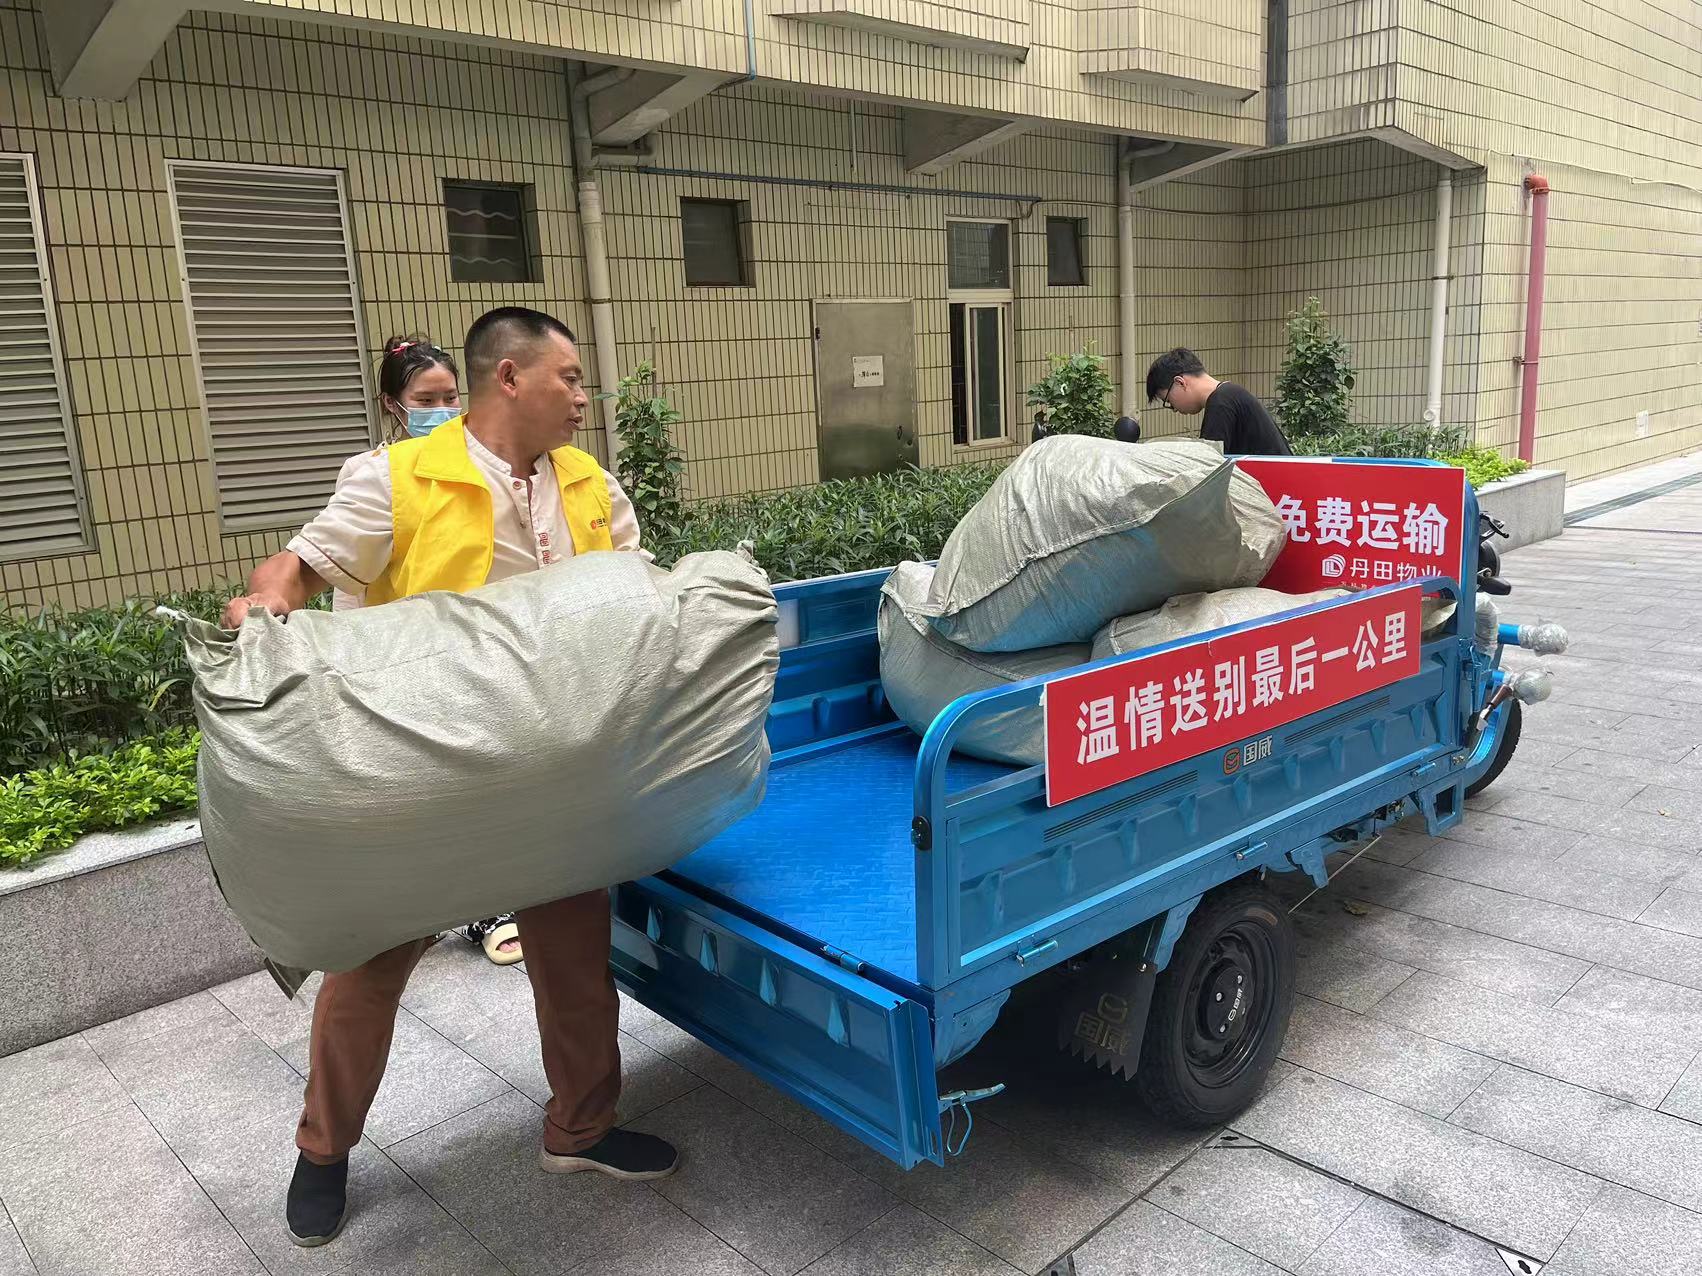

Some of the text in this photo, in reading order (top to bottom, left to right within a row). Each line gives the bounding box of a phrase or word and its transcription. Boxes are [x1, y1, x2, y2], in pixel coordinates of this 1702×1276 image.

[1275, 494, 1448, 556] 免费运输
[1076, 611, 1407, 765] 温情送别最后一公里
[1243, 735, 1273, 766] 国威
